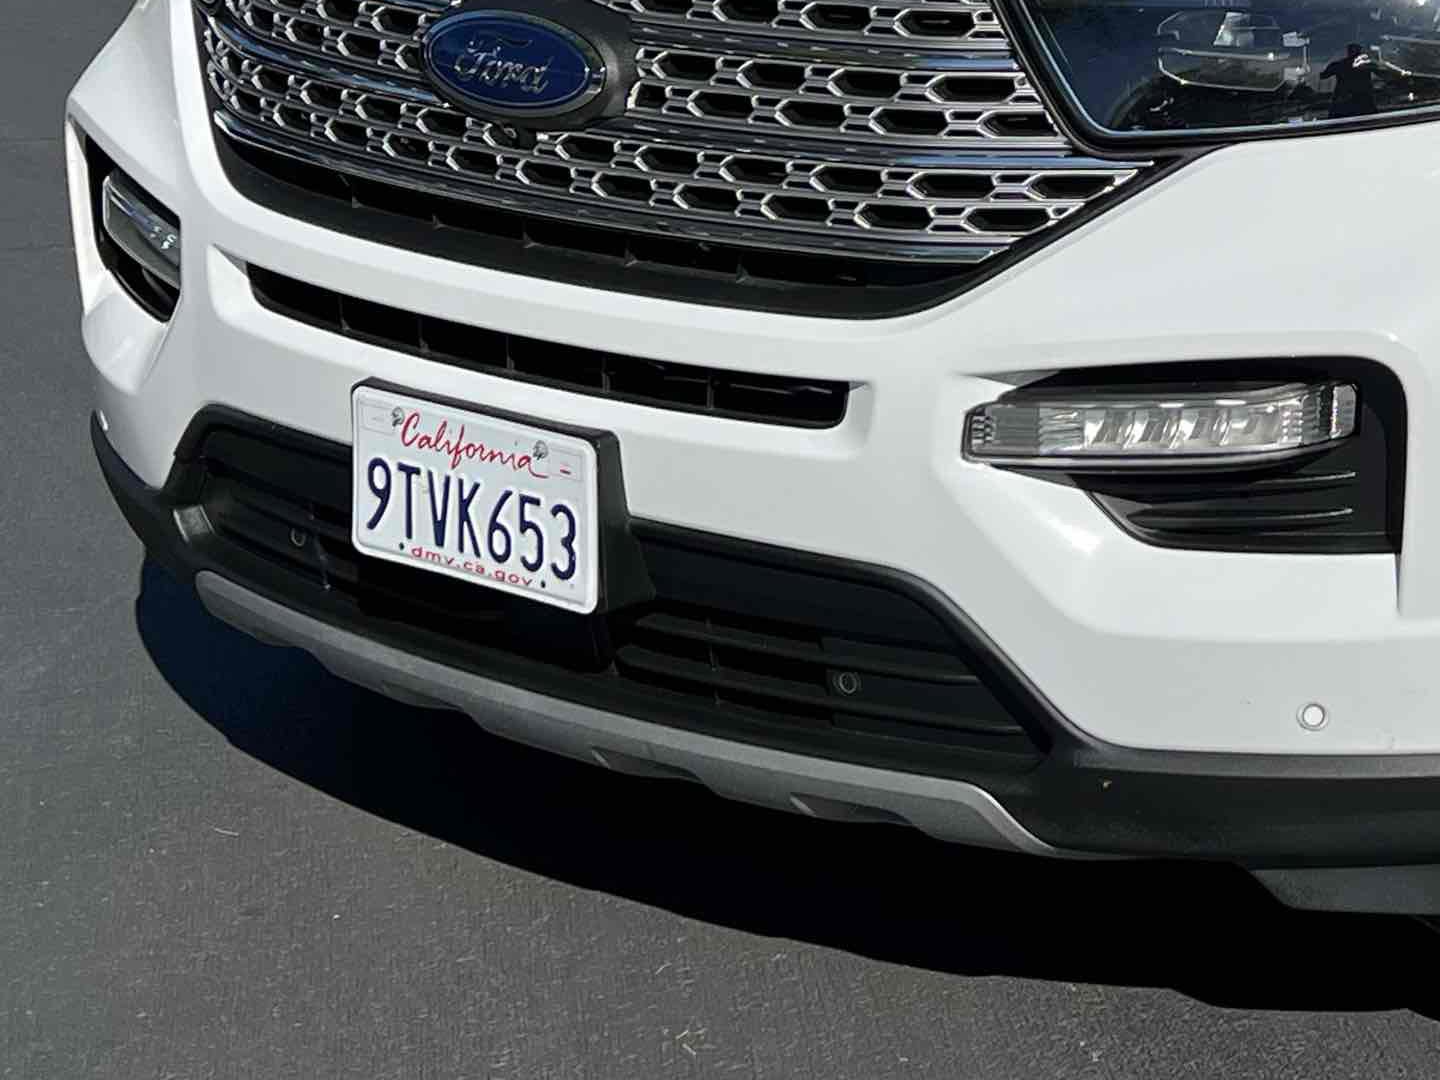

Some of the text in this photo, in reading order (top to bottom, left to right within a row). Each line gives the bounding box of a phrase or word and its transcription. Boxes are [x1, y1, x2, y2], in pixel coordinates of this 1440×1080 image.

[454, 31, 555, 95] Ford
[400, 412, 548, 479] California
[367, 457, 577, 580] 9TVK653
[410, 546, 533, 587] dmv.ca.gov
